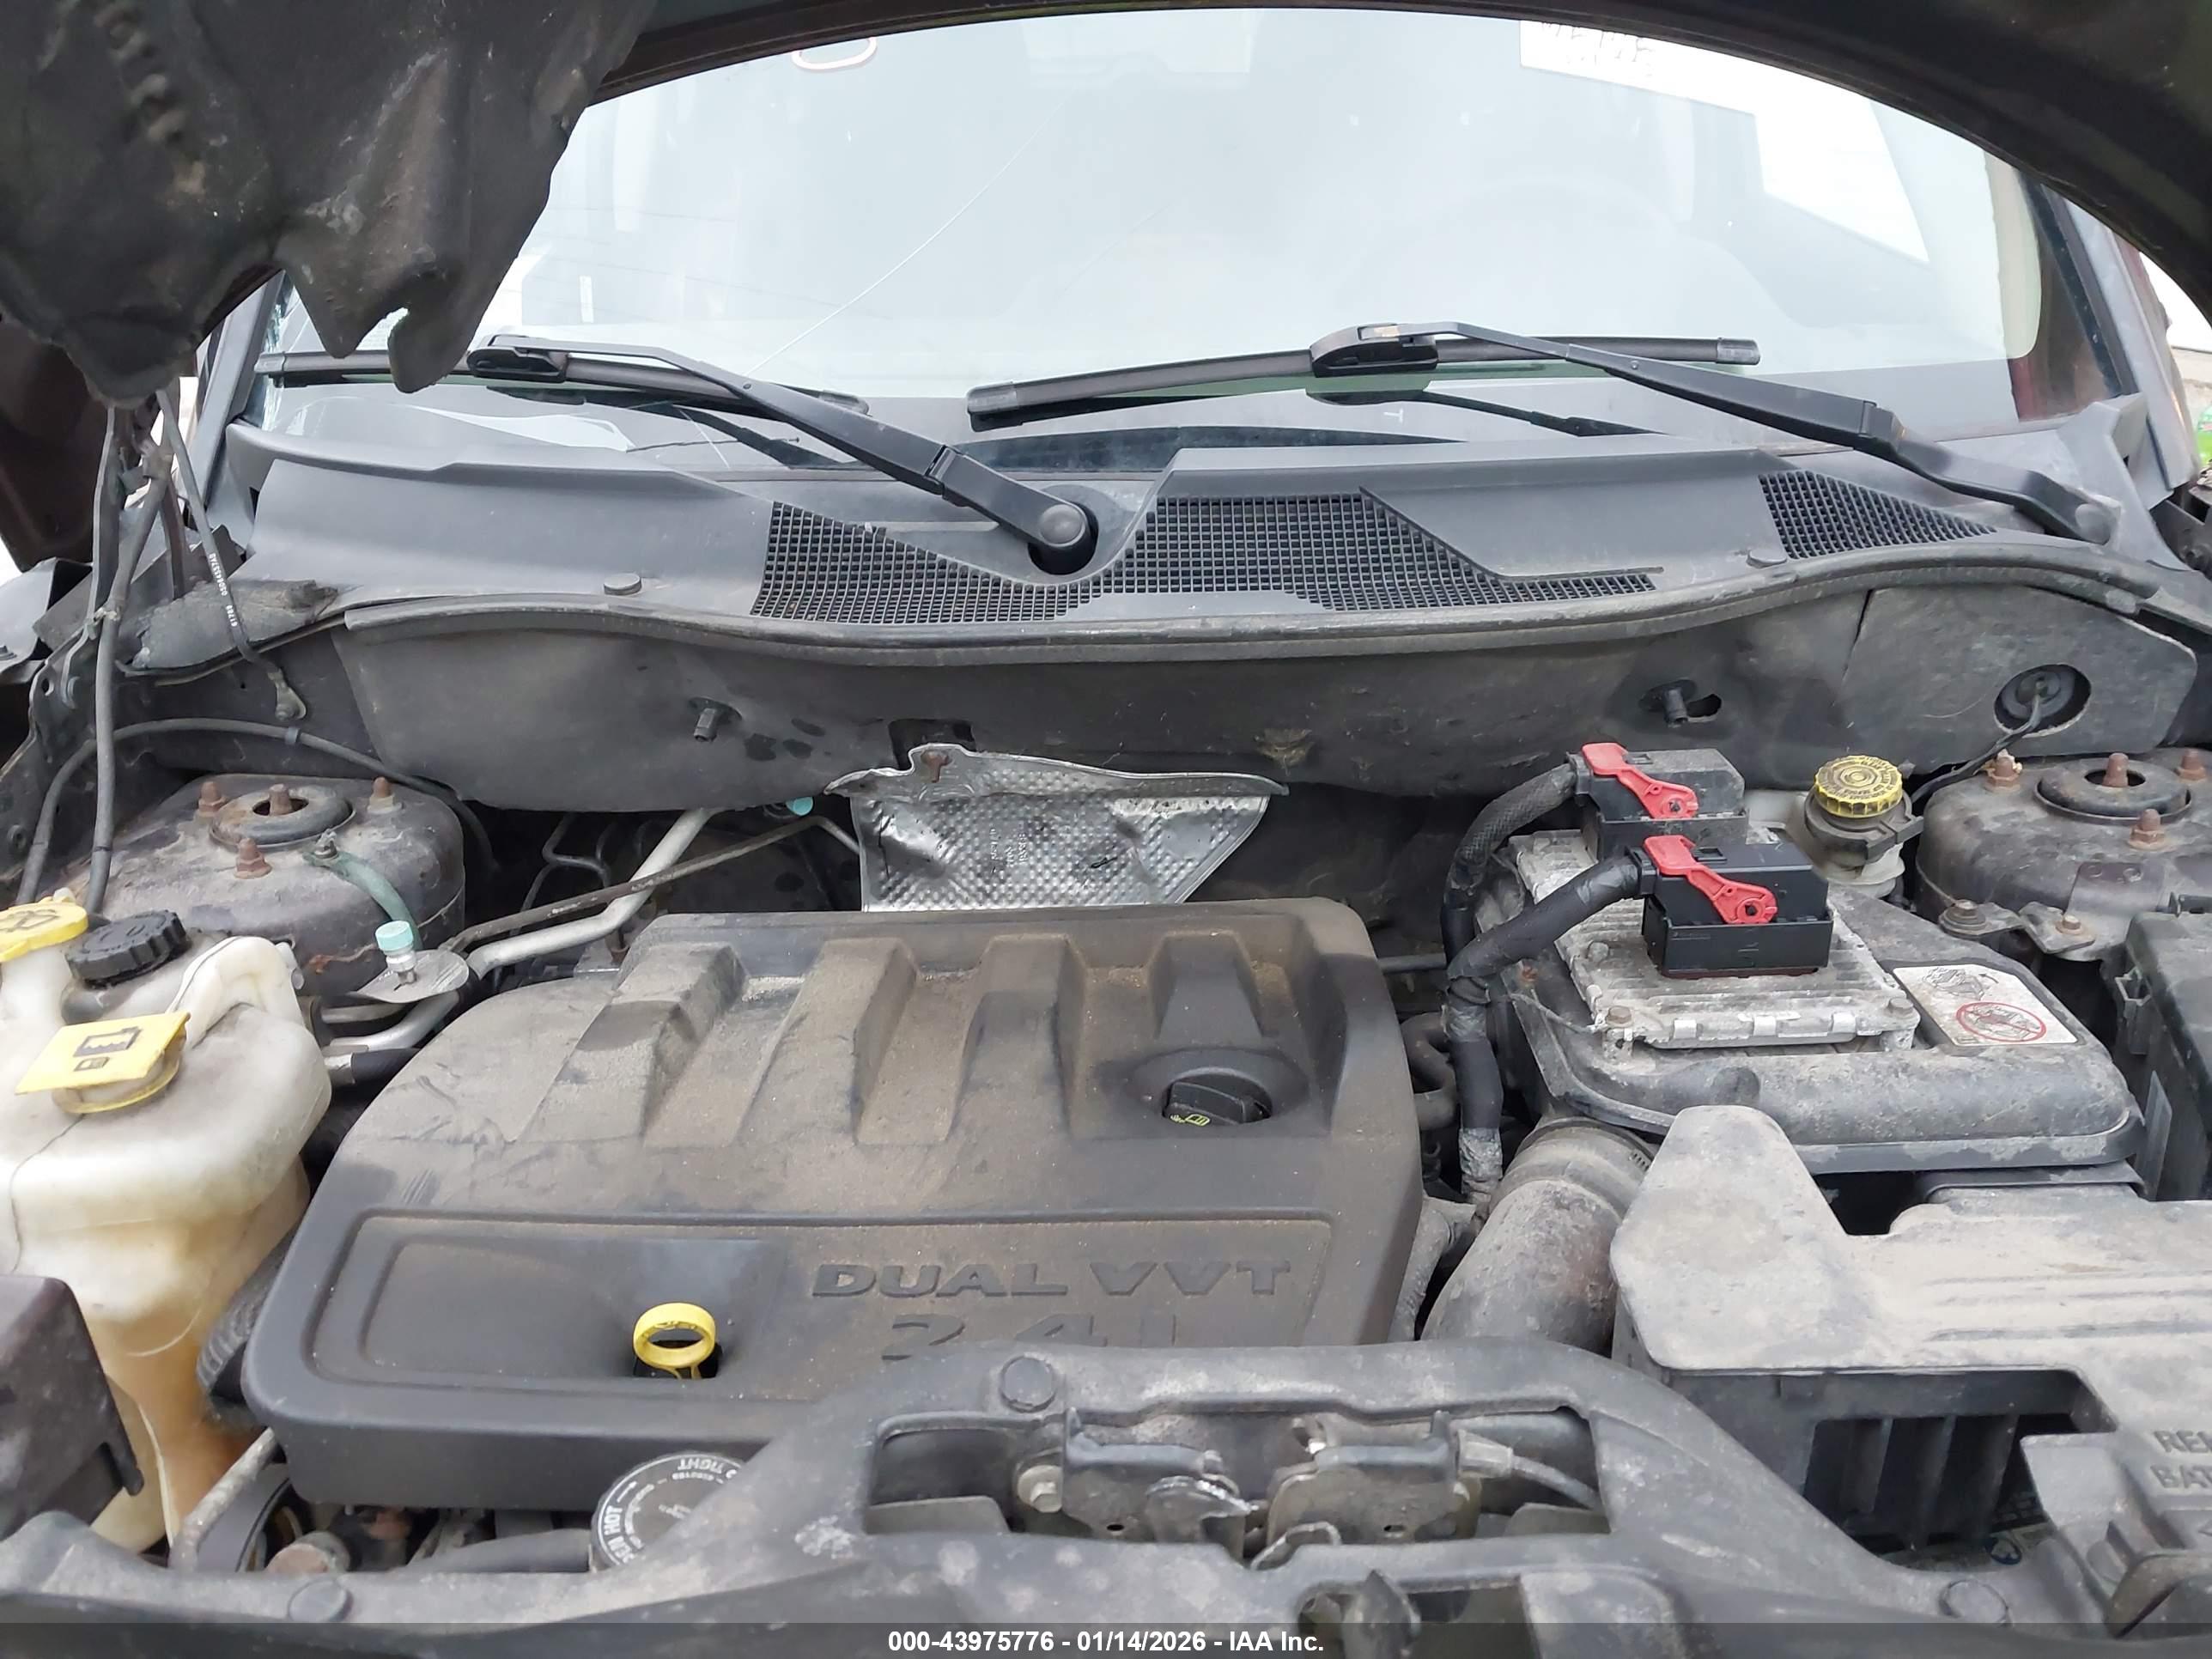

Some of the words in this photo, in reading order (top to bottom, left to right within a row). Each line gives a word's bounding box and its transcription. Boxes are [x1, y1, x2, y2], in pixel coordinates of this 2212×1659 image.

[811, 1262, 1069, 1298] DUAL
[1089, 1260, 1291, 1297] VVT
[678, 1458, 723, 1474] TIGHT
[604, 1505, 623, 1535] HOT
